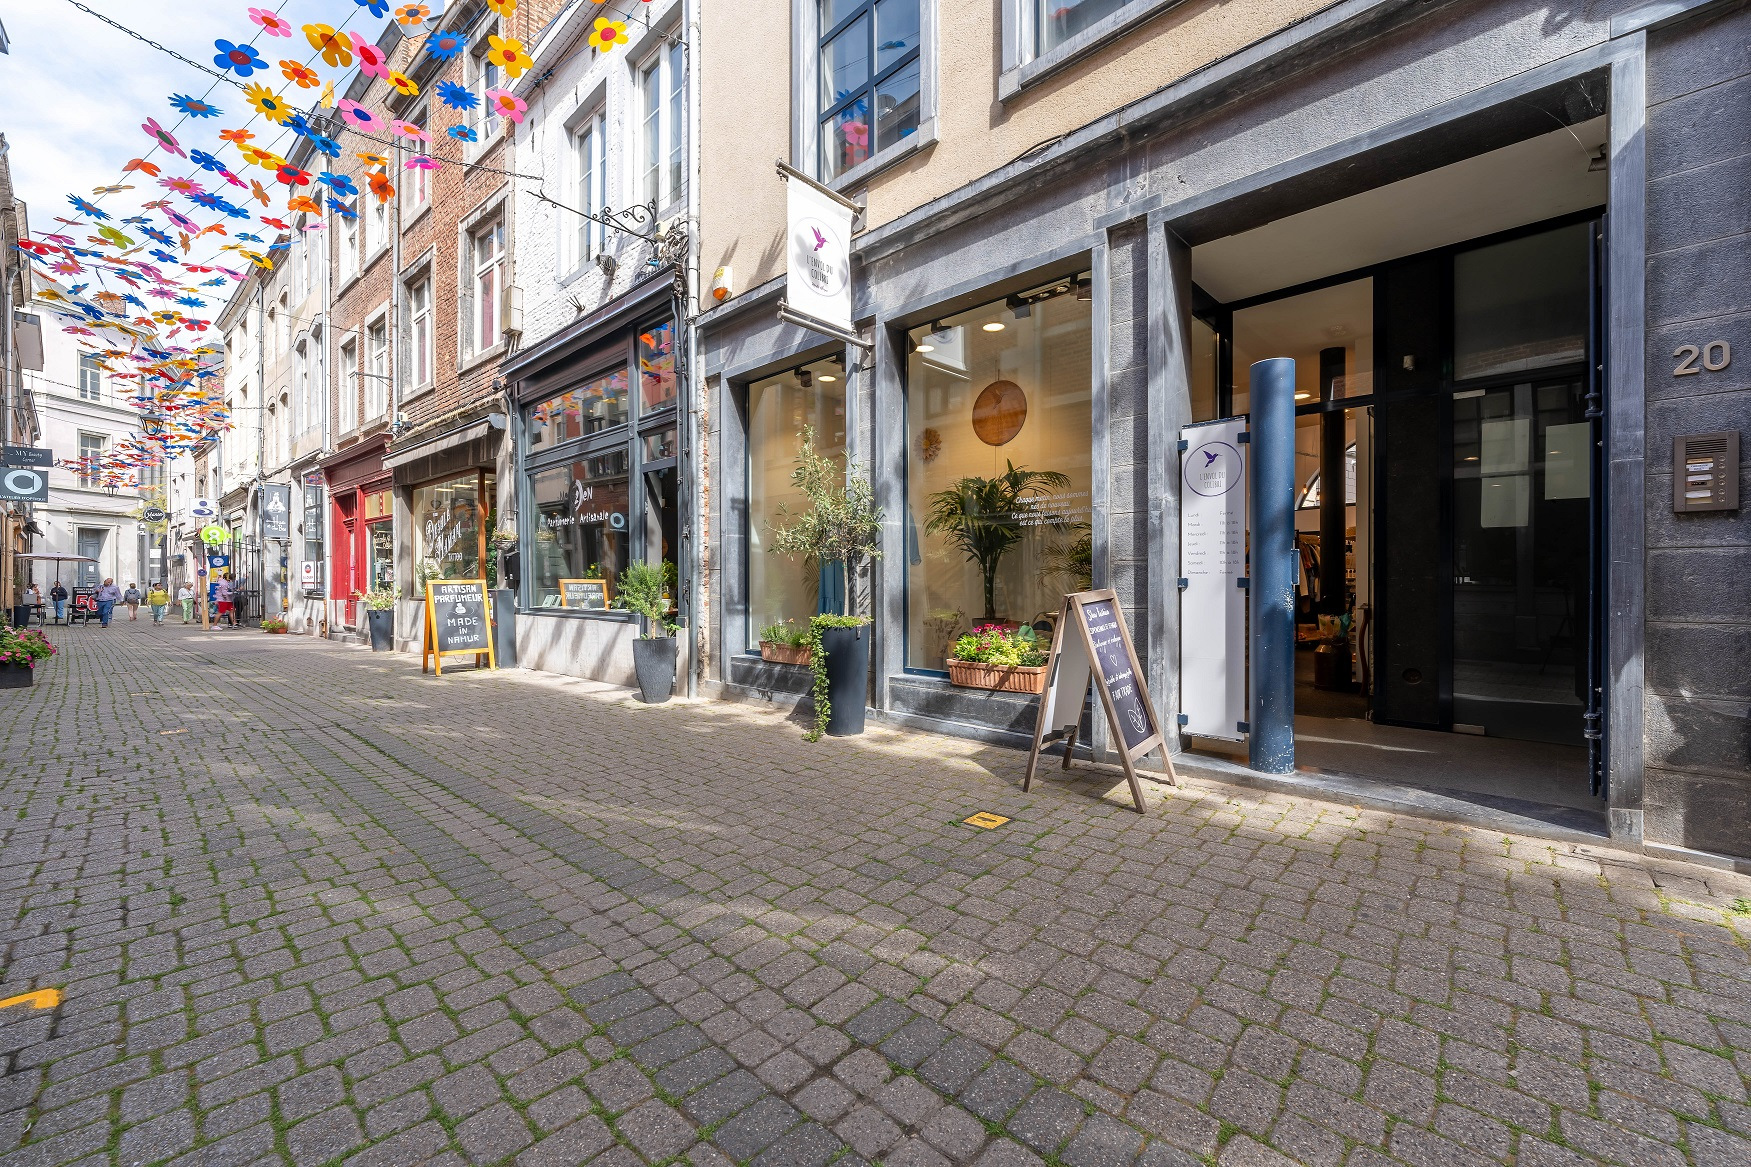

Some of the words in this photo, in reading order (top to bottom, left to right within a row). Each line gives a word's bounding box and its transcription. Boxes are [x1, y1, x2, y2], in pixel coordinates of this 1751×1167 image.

[1673, 340, 1731, 376] 20
[580, 510, 609, 524] Artisanale
[1011, 512, 1019, 520] Ce
[1018, 512, 1029, 521] que
[1027, 518, 1035, 526] ce
[1043, 516, 1064, 526] compte
[441, 584, 477, 594] ARTISAN
[434, 593, 483, 604] PARFUMEUR
[447, 616, 479, 627] MADE
[447, 634, 480, 645] NAMUR
